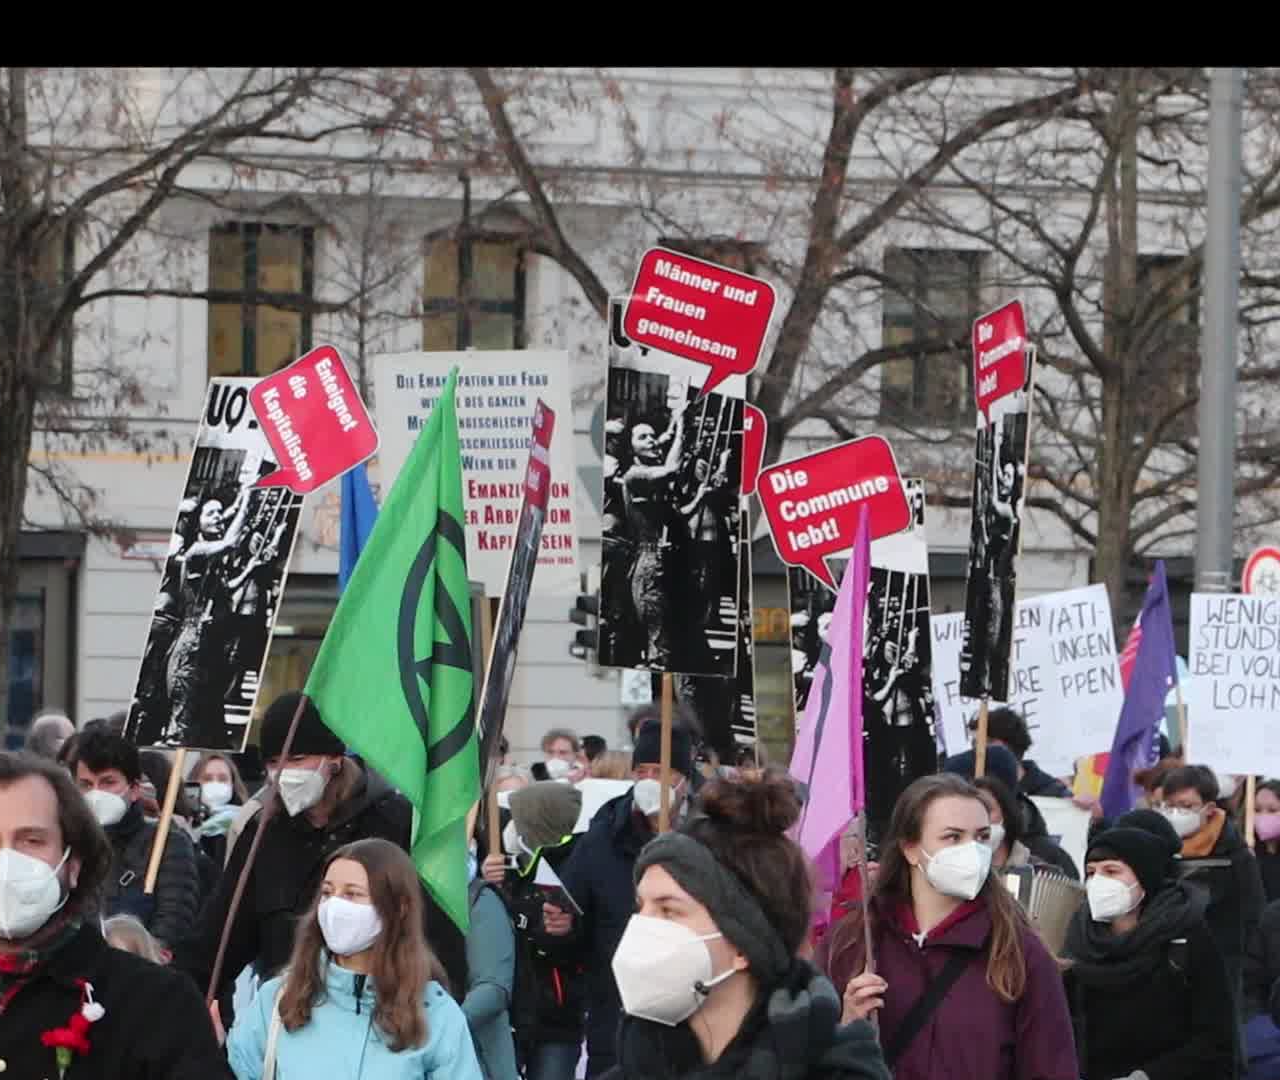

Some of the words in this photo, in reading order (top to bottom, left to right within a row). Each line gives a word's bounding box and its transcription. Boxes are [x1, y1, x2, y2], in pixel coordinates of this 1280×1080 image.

[654, 259, 721, 294] Männer
[723, 284, 758, 306] und
[646, 287, 706, 321] Frauen
[637, 318, 737, 360] gemeinsam
[288, 375, 308, 399] die
[521, 372, 548, 387] FRAU
[315, 358, 358, 432] Enteignet
[488, 396, 526, 409] GANZEN
[261, 387, 313, 482] Kapitalisten
[462, 456, 494, 471] WERK
[770, 469, 809, 494] Die
[779, 475, 890, 522] Commune
[542, 533, 572, 549] SEIN
[788, 517, 841, 552] lebt!
[1193, 652, 1231, 676] BEI
